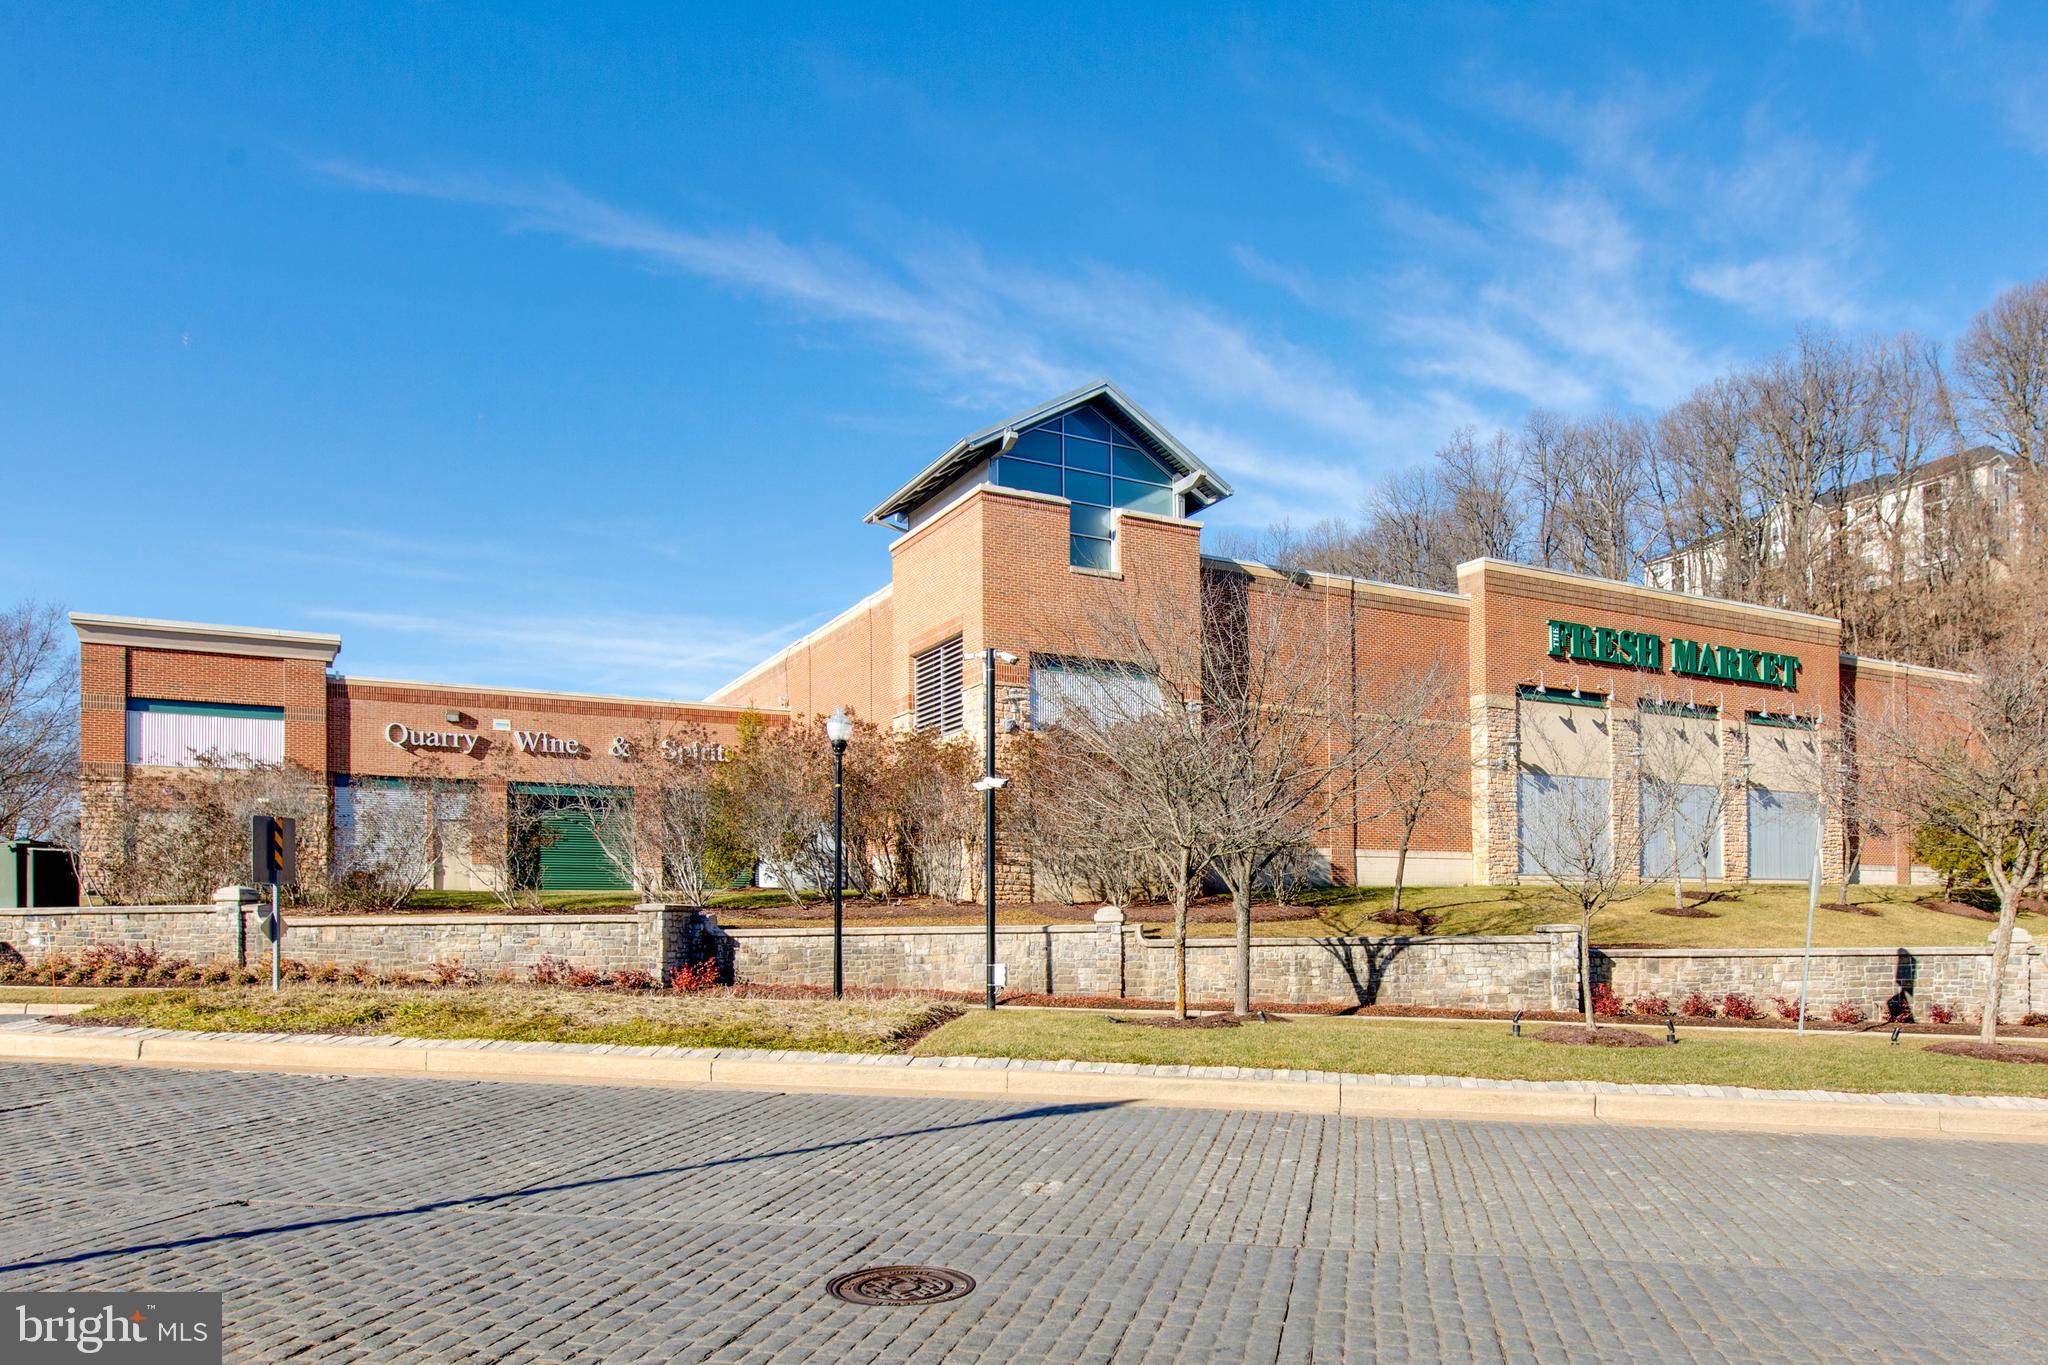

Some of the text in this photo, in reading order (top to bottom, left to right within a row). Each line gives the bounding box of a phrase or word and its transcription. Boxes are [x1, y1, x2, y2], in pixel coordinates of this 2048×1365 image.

[1546, 619, 1800, 688] FRESH MARKET
[1552, 627, 1560, 648] THE
[384, 722, 480, 755] Quarry
[512, 730, 580, 754] Wine
[608, 736, 631, 757] &
